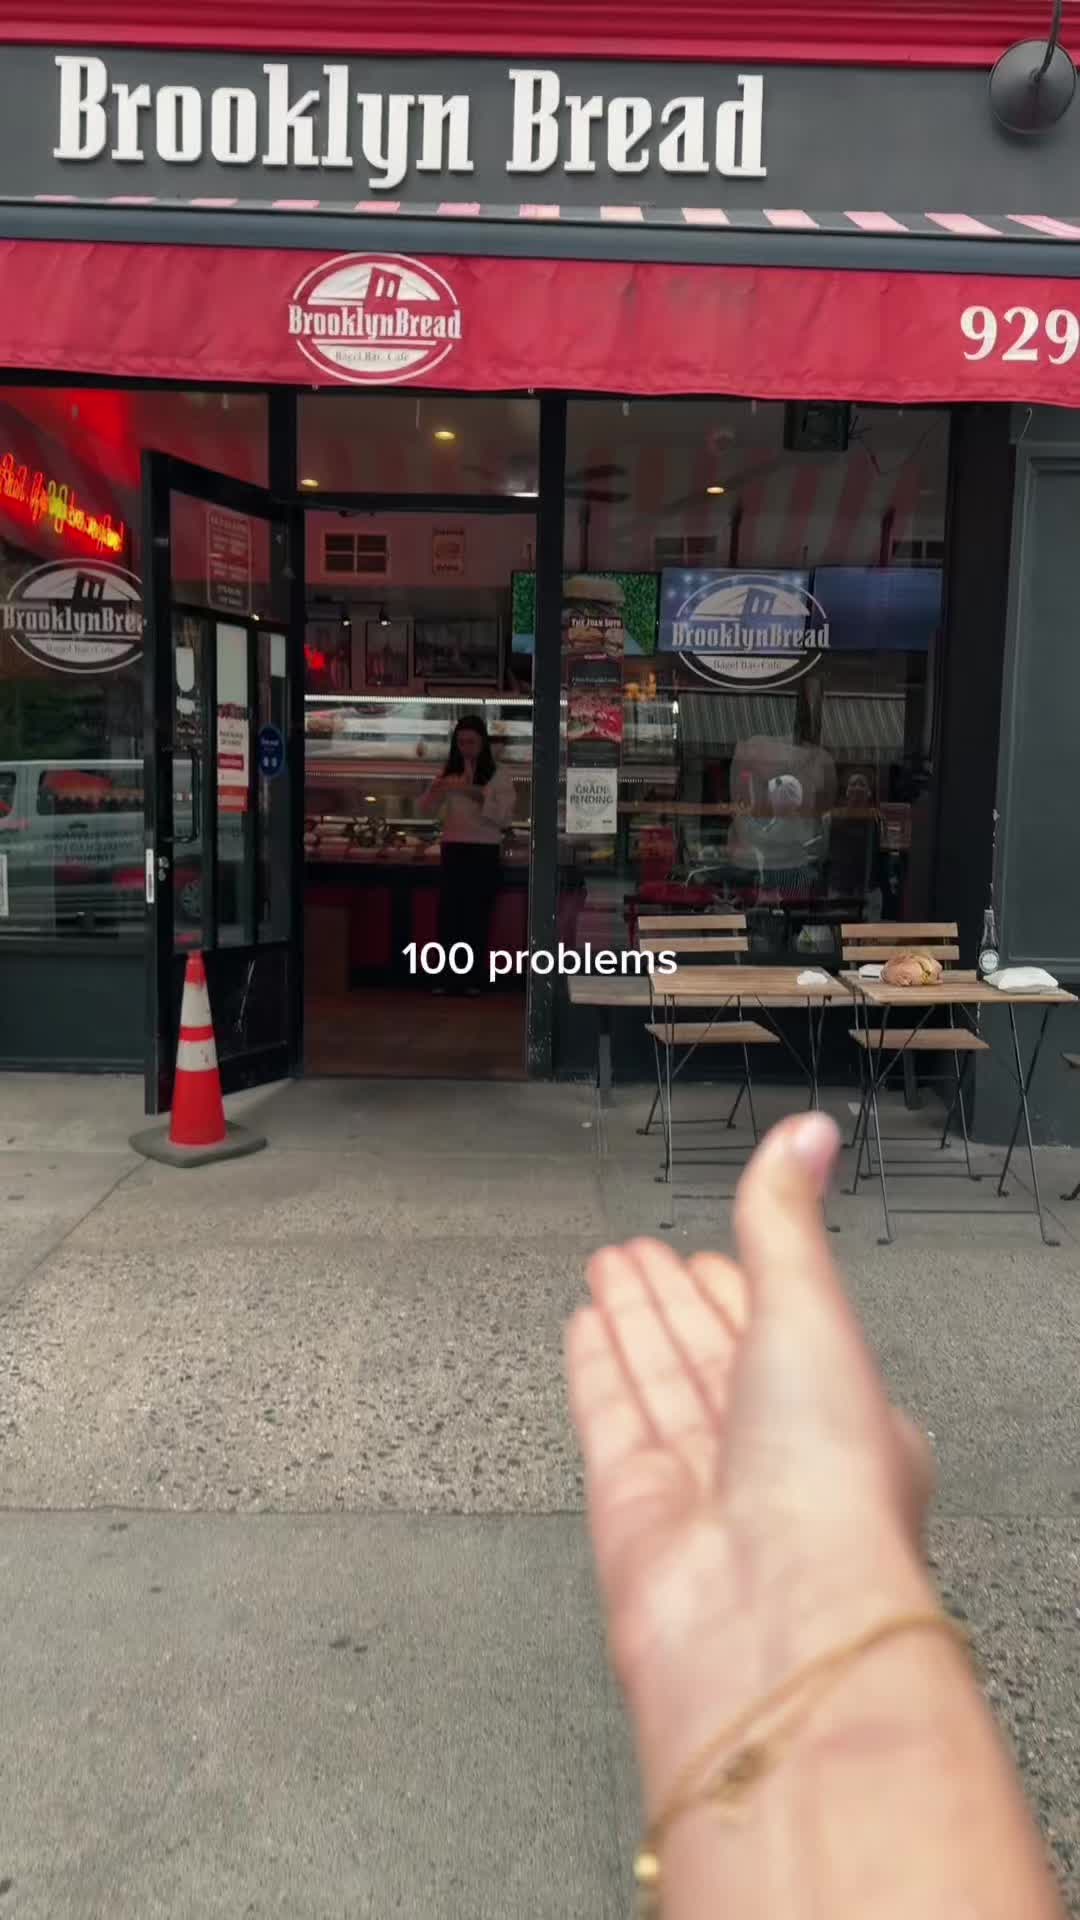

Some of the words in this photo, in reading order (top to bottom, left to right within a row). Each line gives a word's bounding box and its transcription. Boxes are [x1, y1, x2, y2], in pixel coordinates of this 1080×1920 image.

[53, 55, 474, 189] Brooklyn
[505, 68, 767, 178] Bread
[288, 304, 462, 342] BrooklynBread
[960, 305, 1080, 366] 929
[671, 622, 830, 650] BrooklynBread
